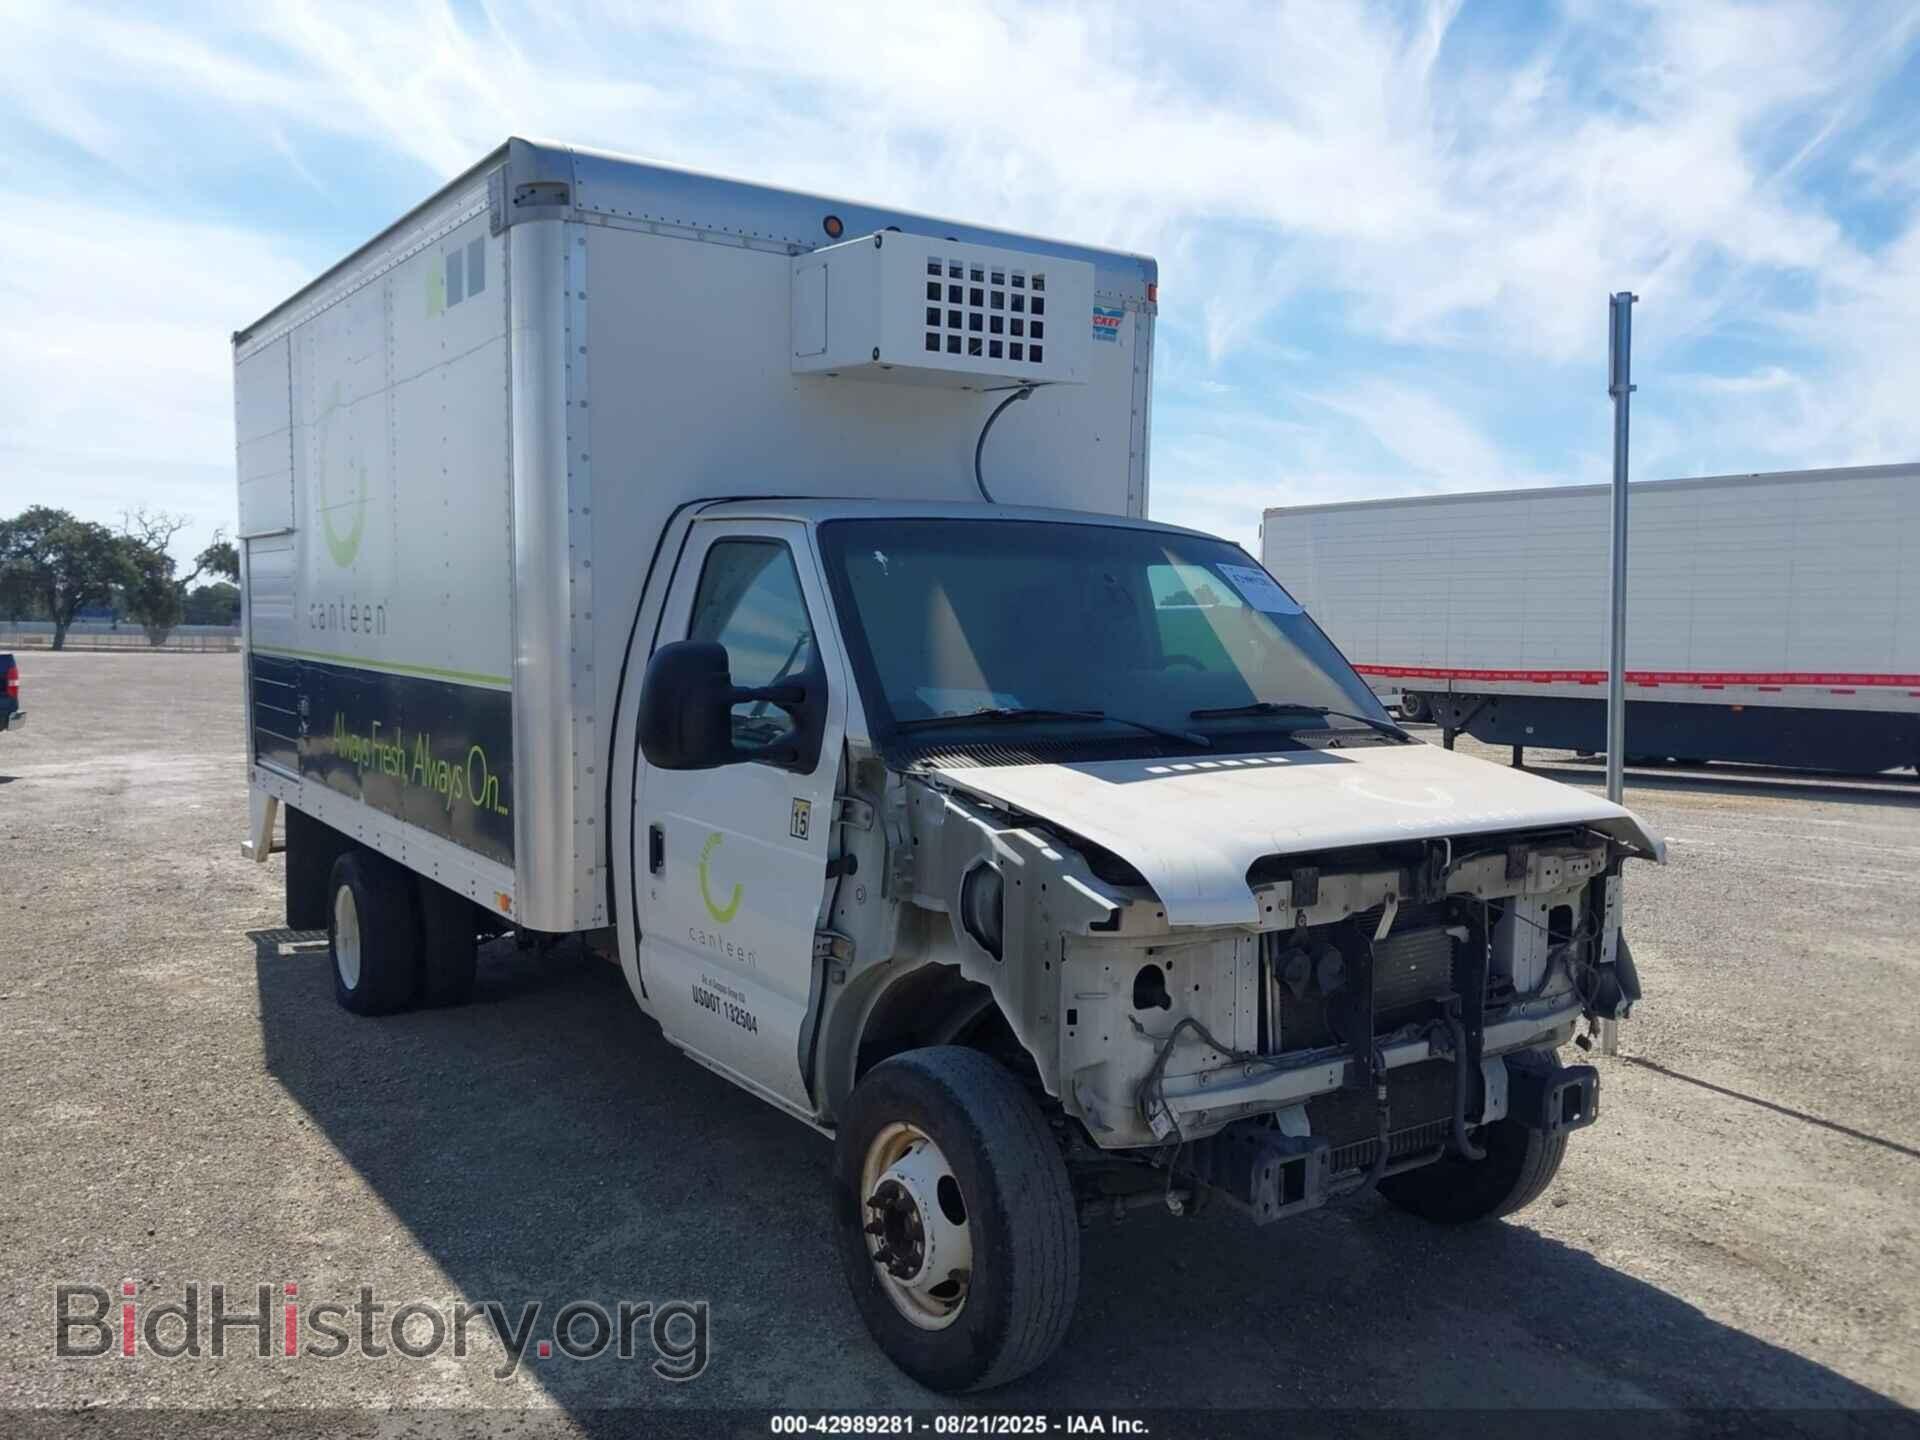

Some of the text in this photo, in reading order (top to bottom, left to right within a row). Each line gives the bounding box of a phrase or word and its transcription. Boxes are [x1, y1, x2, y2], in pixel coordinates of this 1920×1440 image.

[309, 597, 387, 634] canteen
[411, 731, 463, 811] Always
[794, 808, 807, 836] 15
[689, 927, 757, 968] canteen
[692, 984, 721, 1015] USDOT
[723, 1001, 759, 1036] 132504
